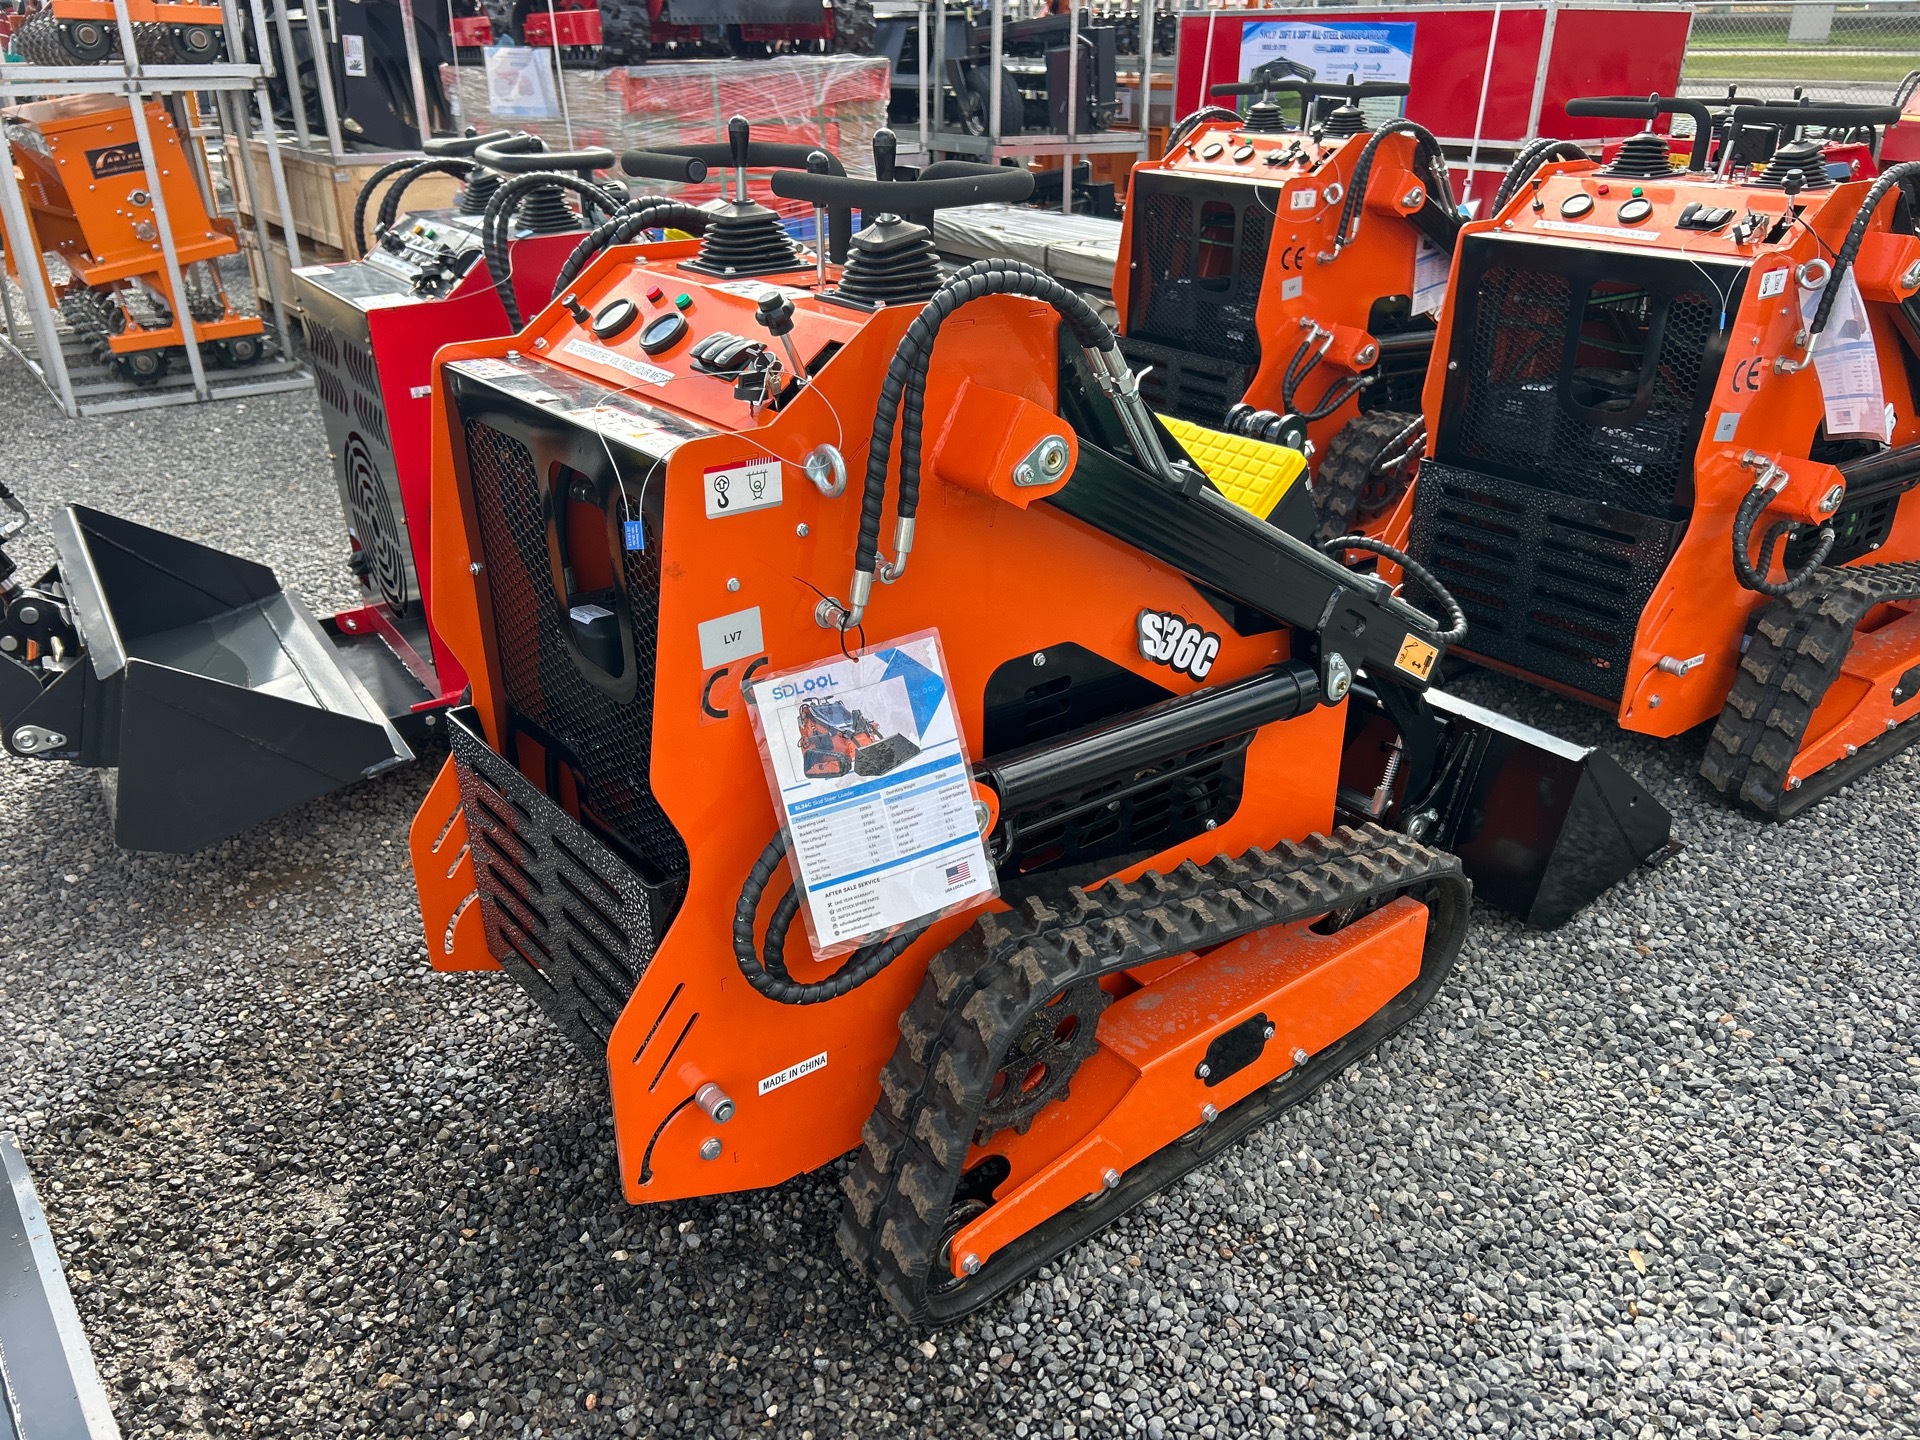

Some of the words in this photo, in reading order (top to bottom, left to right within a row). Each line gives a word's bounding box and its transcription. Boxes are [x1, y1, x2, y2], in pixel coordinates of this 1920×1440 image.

[1281, 246, 1306, 270] CE
[577, 344, 611, 362] TEMPERATURE
[610, 355, 635, 370] VOLTAGE
[1732, 356, 1762, 392] CE
[724, 630, 742, 644] LV7
[772, 674, 838, 700] SDLOOL
[824, 889, 842, 898] AFTER
[858, 877, 880, 888] SERVICE
[763, 1072, 786, 1090] MADE
[789, 1068, 798, 1078] IN
[800, 1055, 826, 1073] CHINA
